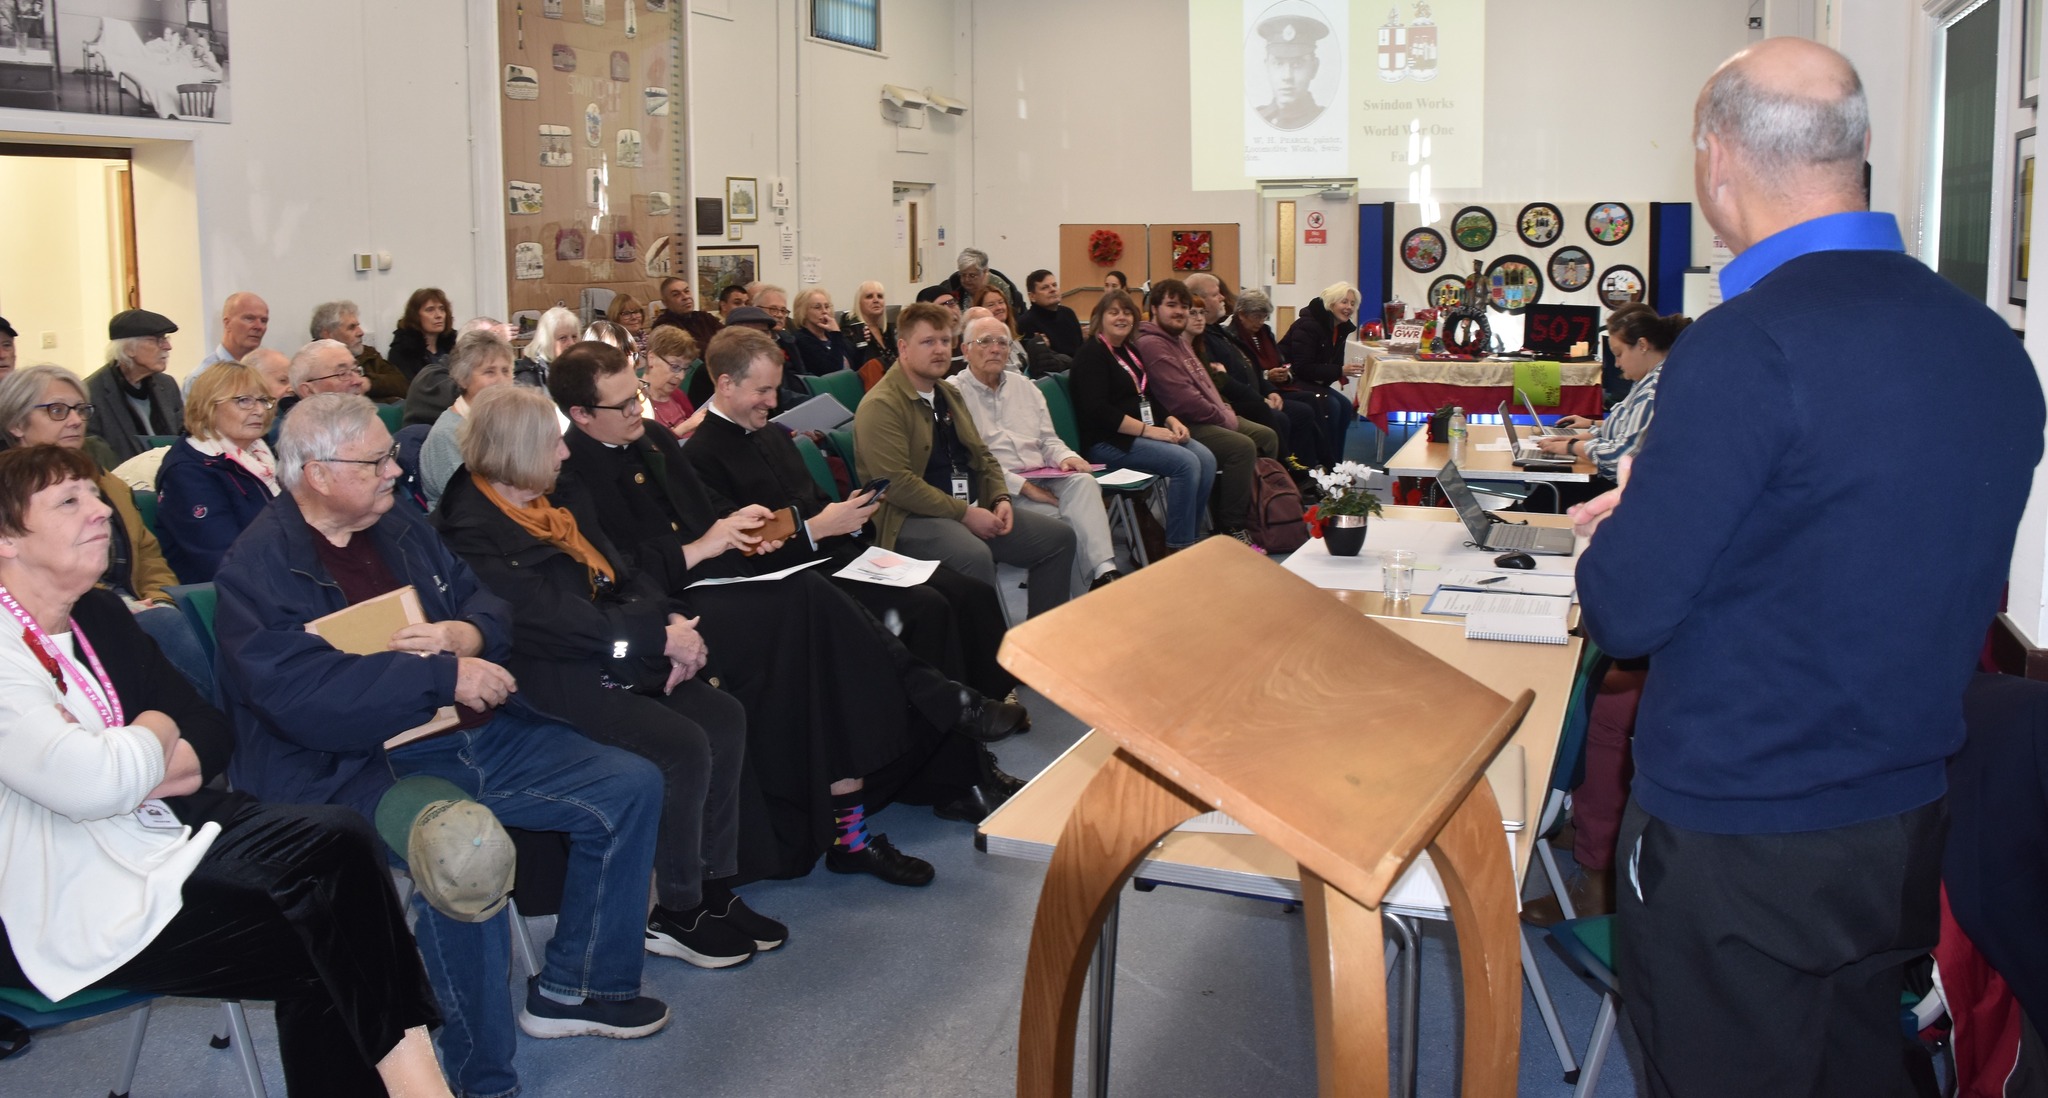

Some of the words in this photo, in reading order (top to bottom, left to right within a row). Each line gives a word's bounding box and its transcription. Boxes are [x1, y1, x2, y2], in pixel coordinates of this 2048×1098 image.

[1363, 99, 1412, 111] Swindon
[1416, 97, 1454, 109] Works
[1362, 125, 1399, 136] World
[1402, 124, 1428, 136] Wr
[1430, 124, 1455, 135] One
[1394, 329, 1420, 339] GWR
[1530, 313, 1591, 343] 507
